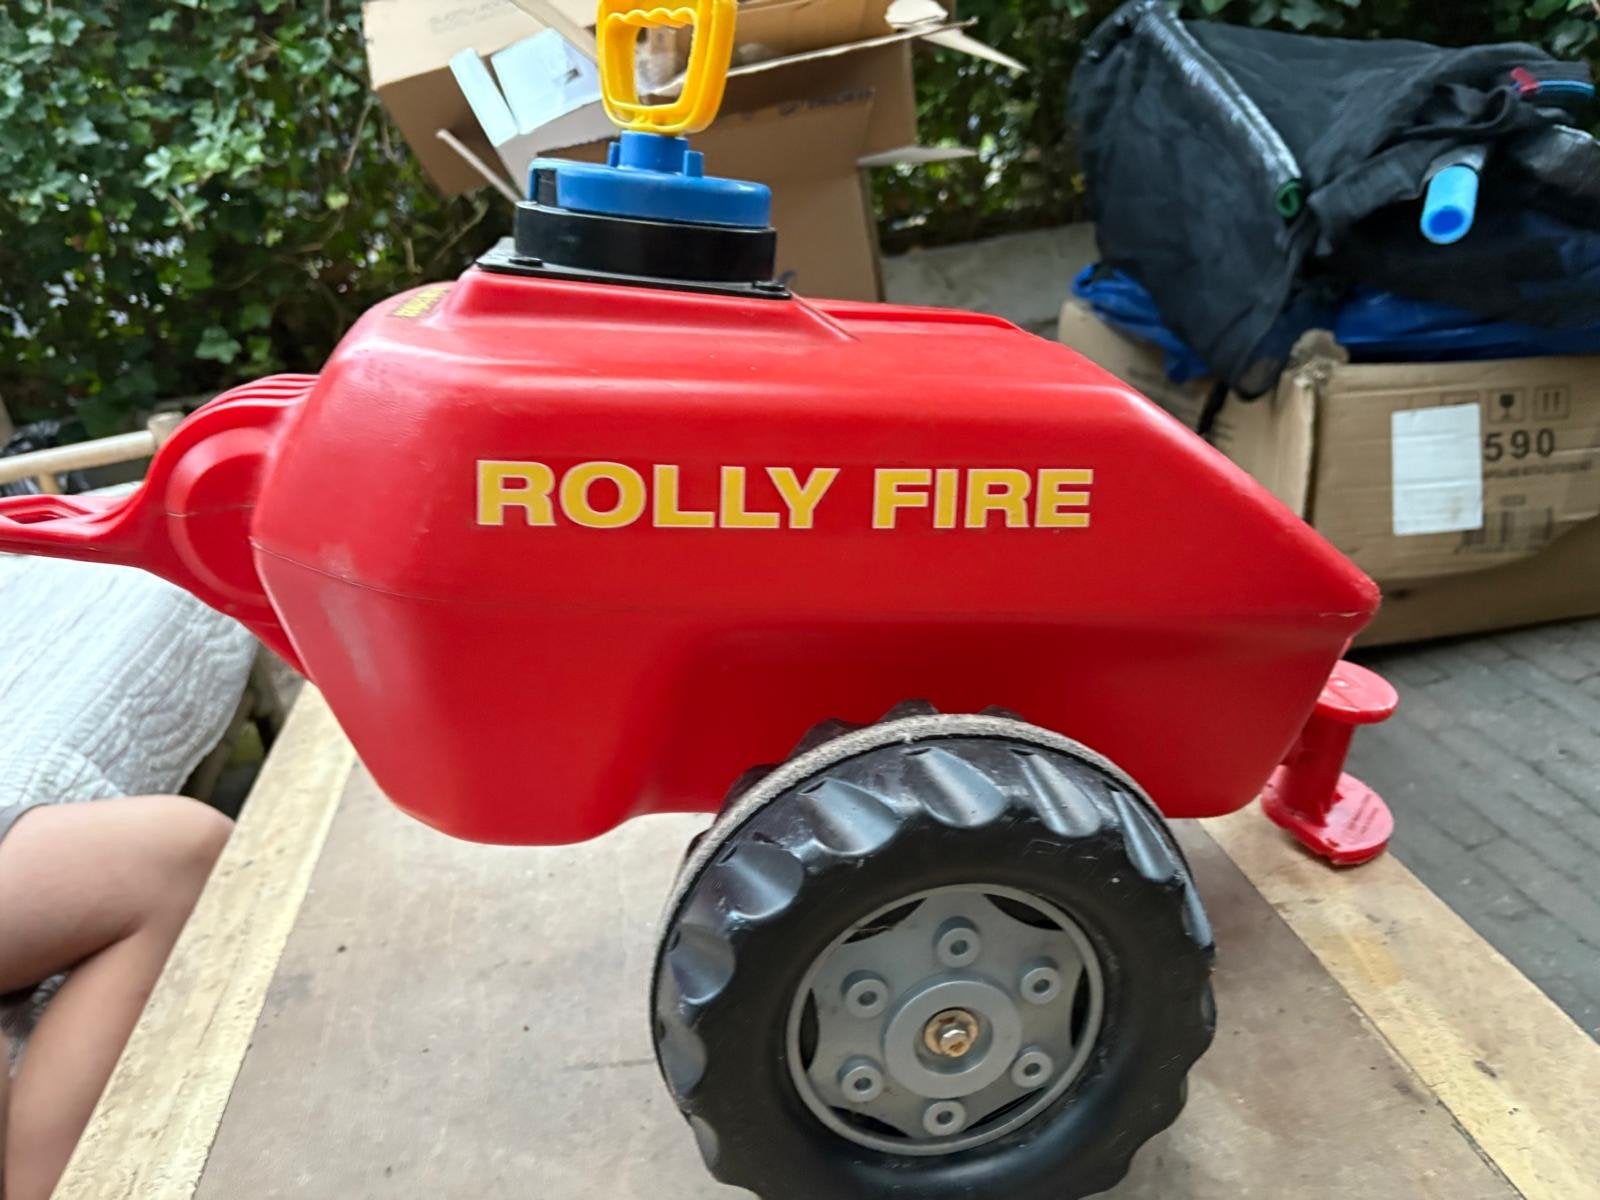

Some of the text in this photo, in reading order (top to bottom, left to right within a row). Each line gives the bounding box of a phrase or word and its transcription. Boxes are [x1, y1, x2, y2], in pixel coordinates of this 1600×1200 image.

[1484, 428, 1555, 462] 590
[476, 459, 1094, 529] ROLLY FIRE
